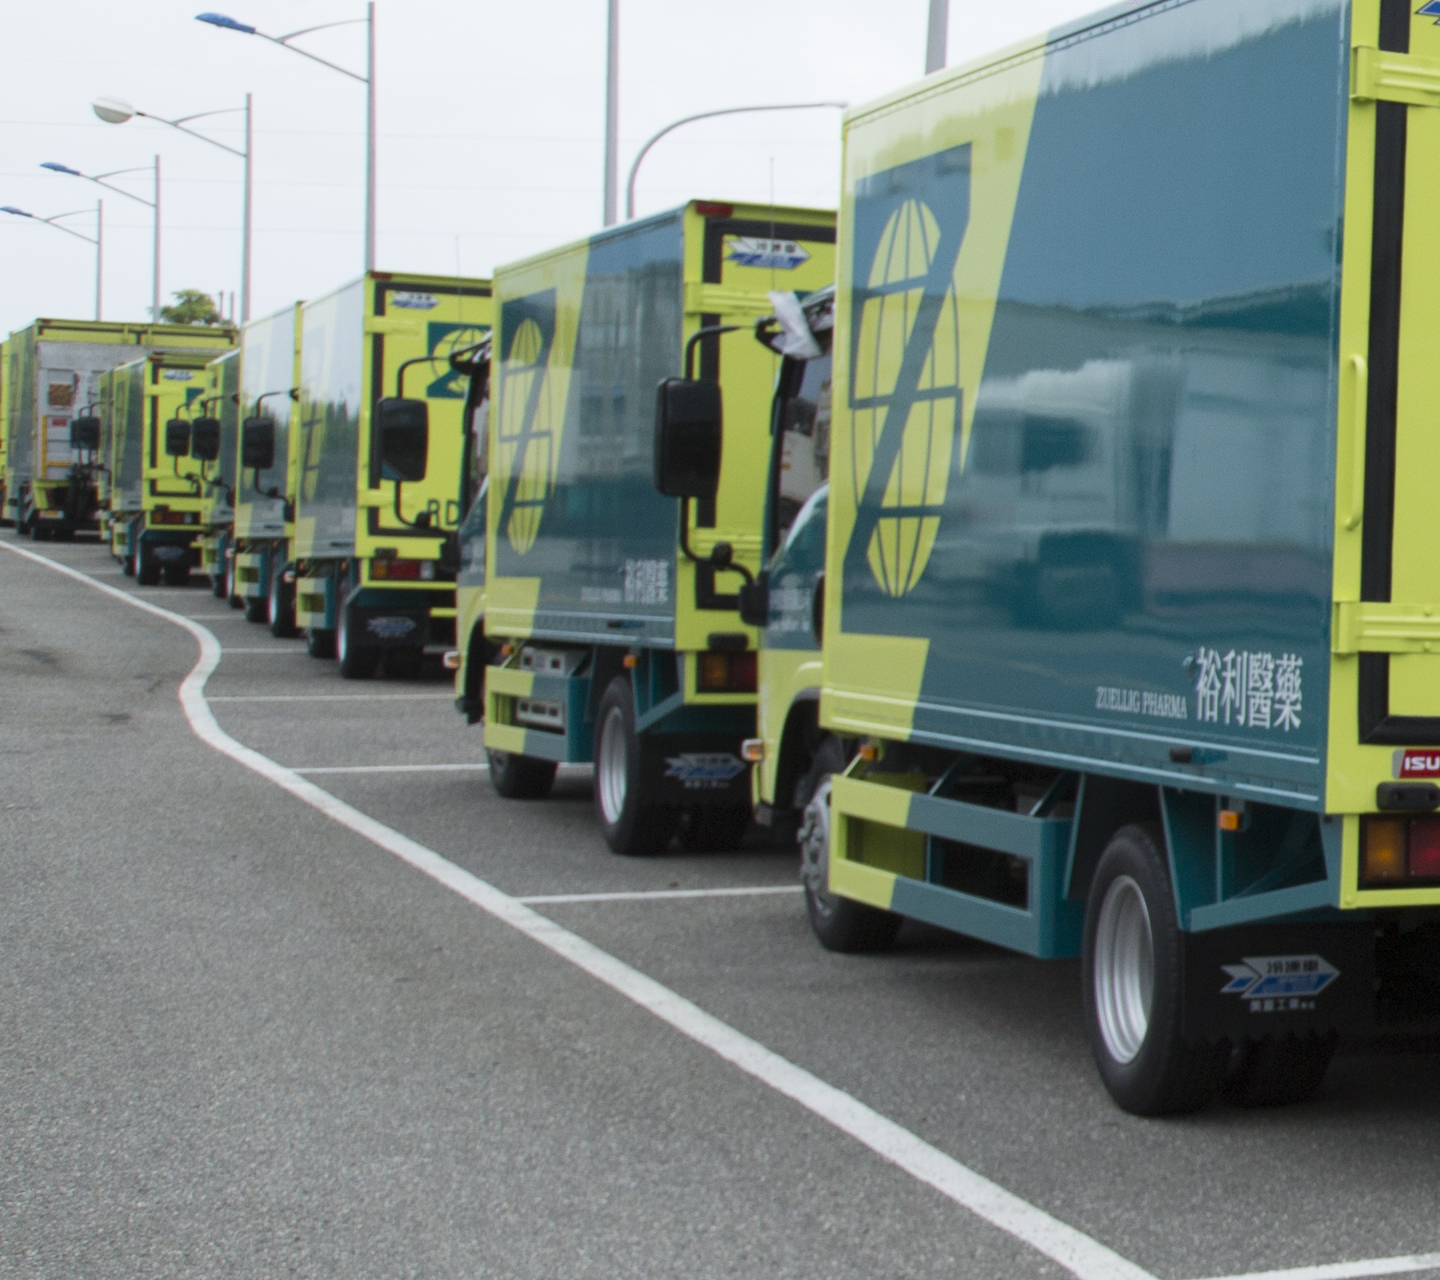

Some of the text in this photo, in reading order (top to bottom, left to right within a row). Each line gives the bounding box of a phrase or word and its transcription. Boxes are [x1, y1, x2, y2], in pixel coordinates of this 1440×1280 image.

[1095, 686, 1188, 720] ZUELLIG PHARMA
[1195, 645, 1304, 732] 裕利醫藥
